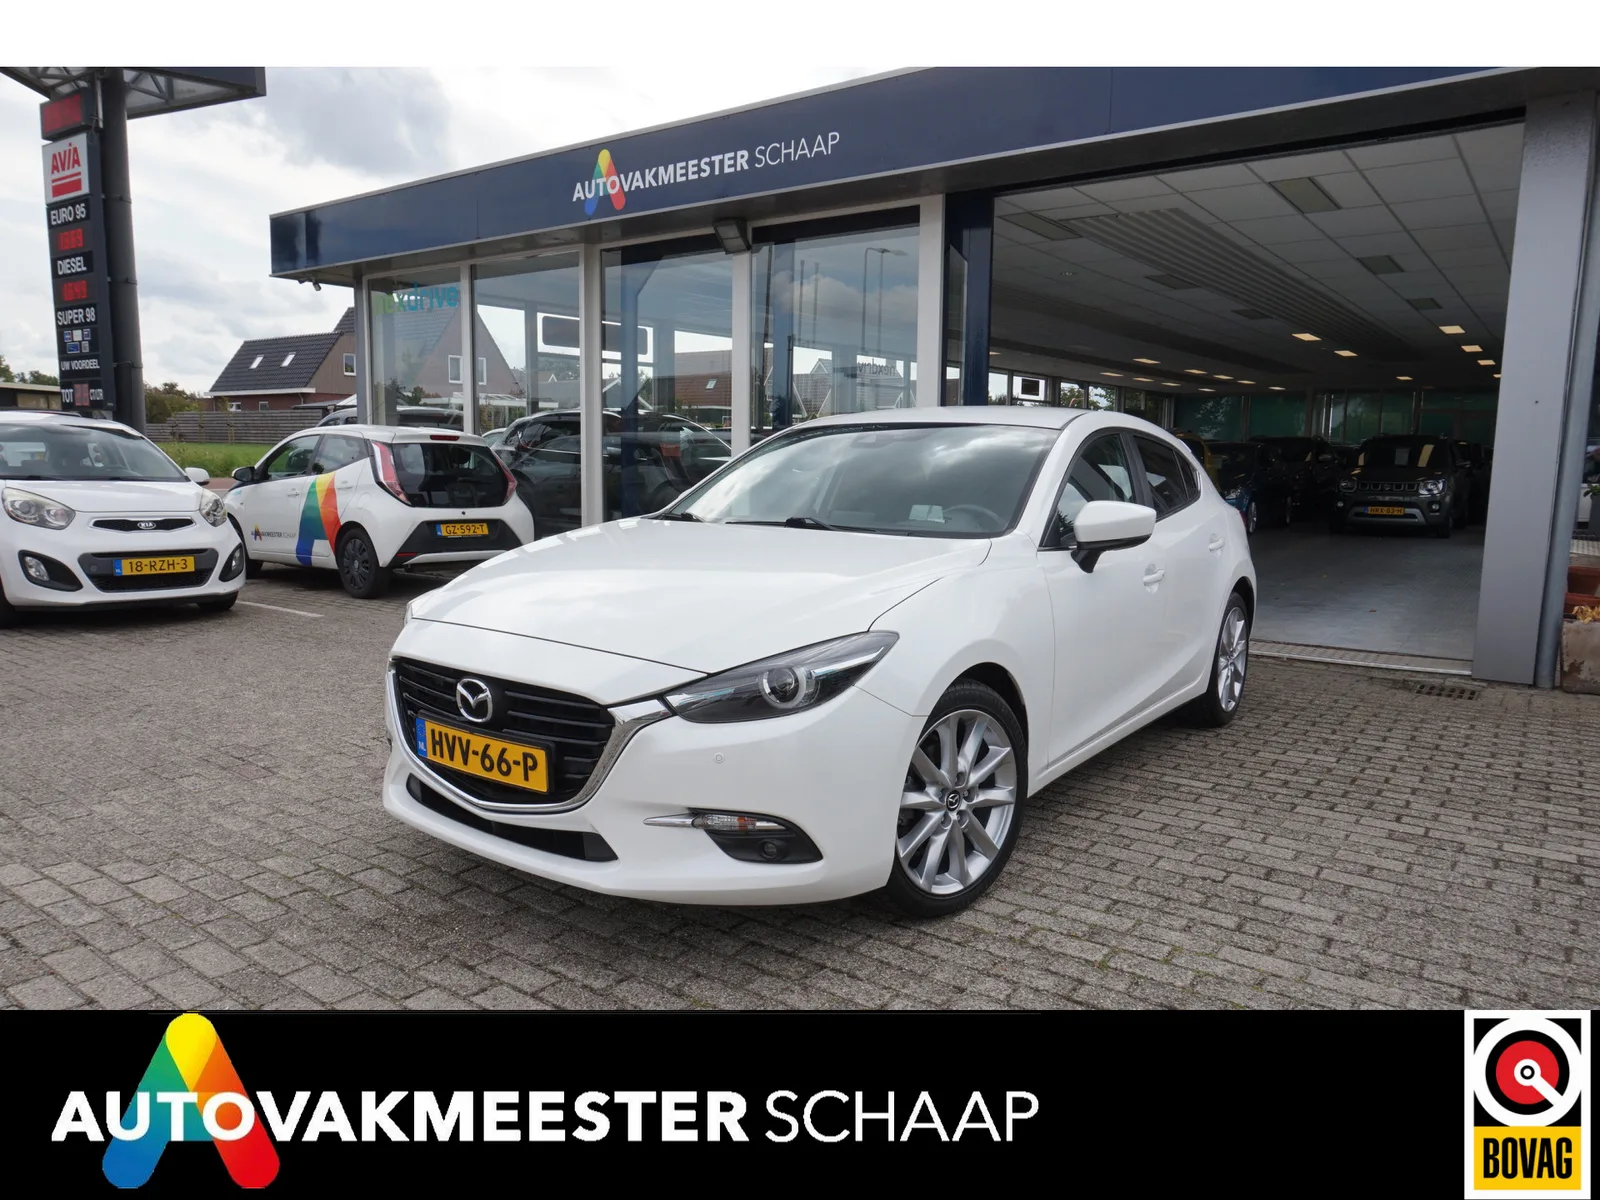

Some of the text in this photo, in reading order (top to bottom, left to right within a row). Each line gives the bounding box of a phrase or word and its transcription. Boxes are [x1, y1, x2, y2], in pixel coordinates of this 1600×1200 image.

[572, 132, 840, 202] AUTOVAKMEESTER SCHAAP
[50, 203, 86, 225] EURO 95
[57, 256, 87, 275] DIESEL
[57, 307, 96, 325] SUPER 98
[61, 359, 100, 371] UW VOORDEEL
[61, 388, 74, 403] TOT
[445, 524, 485, 535] GZ-592-T
[129, 559, 188, 573] 18-RZH-3
[418, 729, 538, 782] NL HVV-66-P
